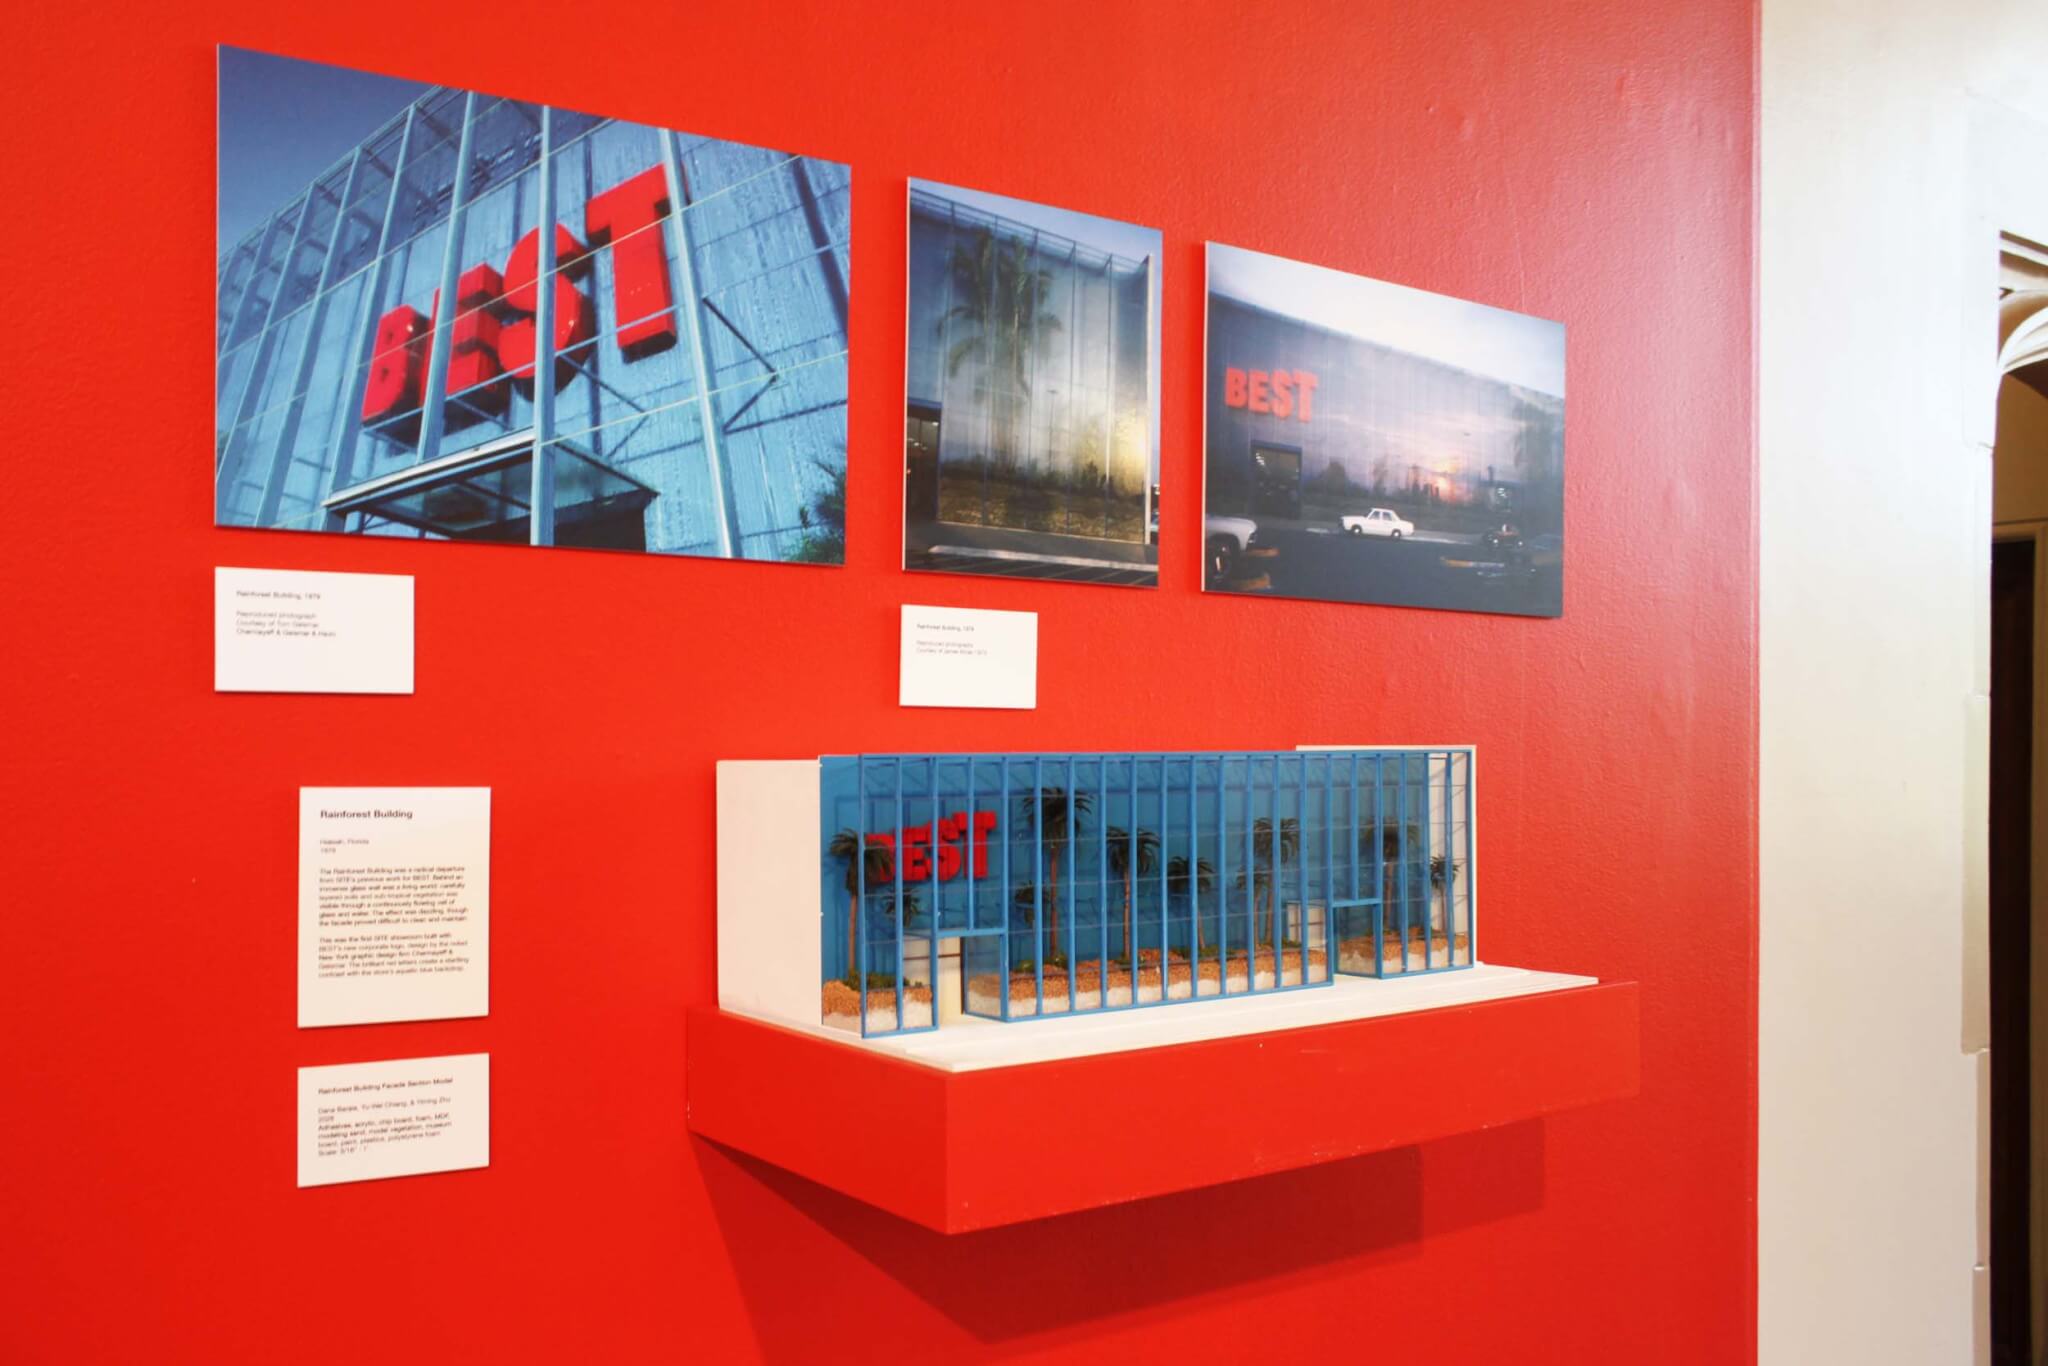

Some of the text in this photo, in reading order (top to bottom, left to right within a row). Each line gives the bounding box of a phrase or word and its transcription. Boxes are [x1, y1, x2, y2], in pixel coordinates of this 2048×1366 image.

[361, 160, 690, 432] BEST
[1225, 367, 1318, 423] BEST
[320, 808, 413, 820] Rainforest Building
[318, 1085, 353, 1095] Rainforest
[353, 1083, 381, 1093] Building
[433, 1078, 454, 1087] Model
